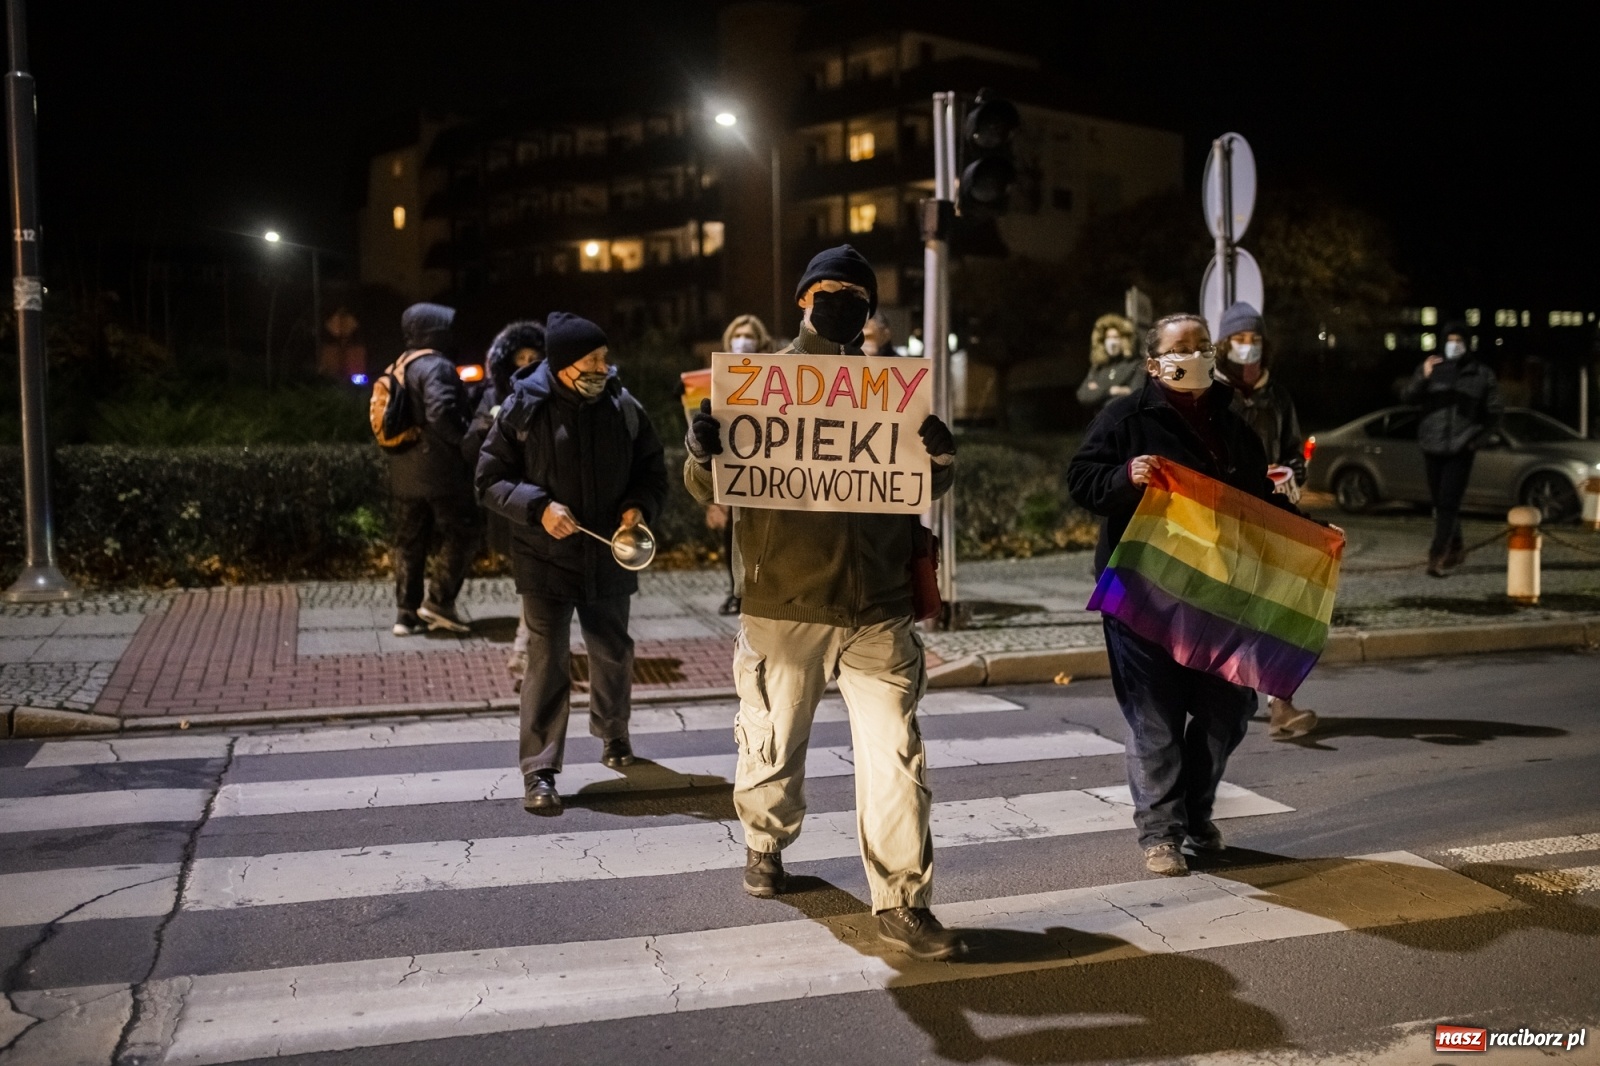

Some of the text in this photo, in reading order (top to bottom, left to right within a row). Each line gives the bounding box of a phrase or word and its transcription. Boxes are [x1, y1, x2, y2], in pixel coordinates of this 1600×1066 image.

[726, 357, 929, 415] ŻĄDAMY
[728, 414, 900, 464] OPIEKI
[723, 463, 923, 507] ZDROWOTNEJ
